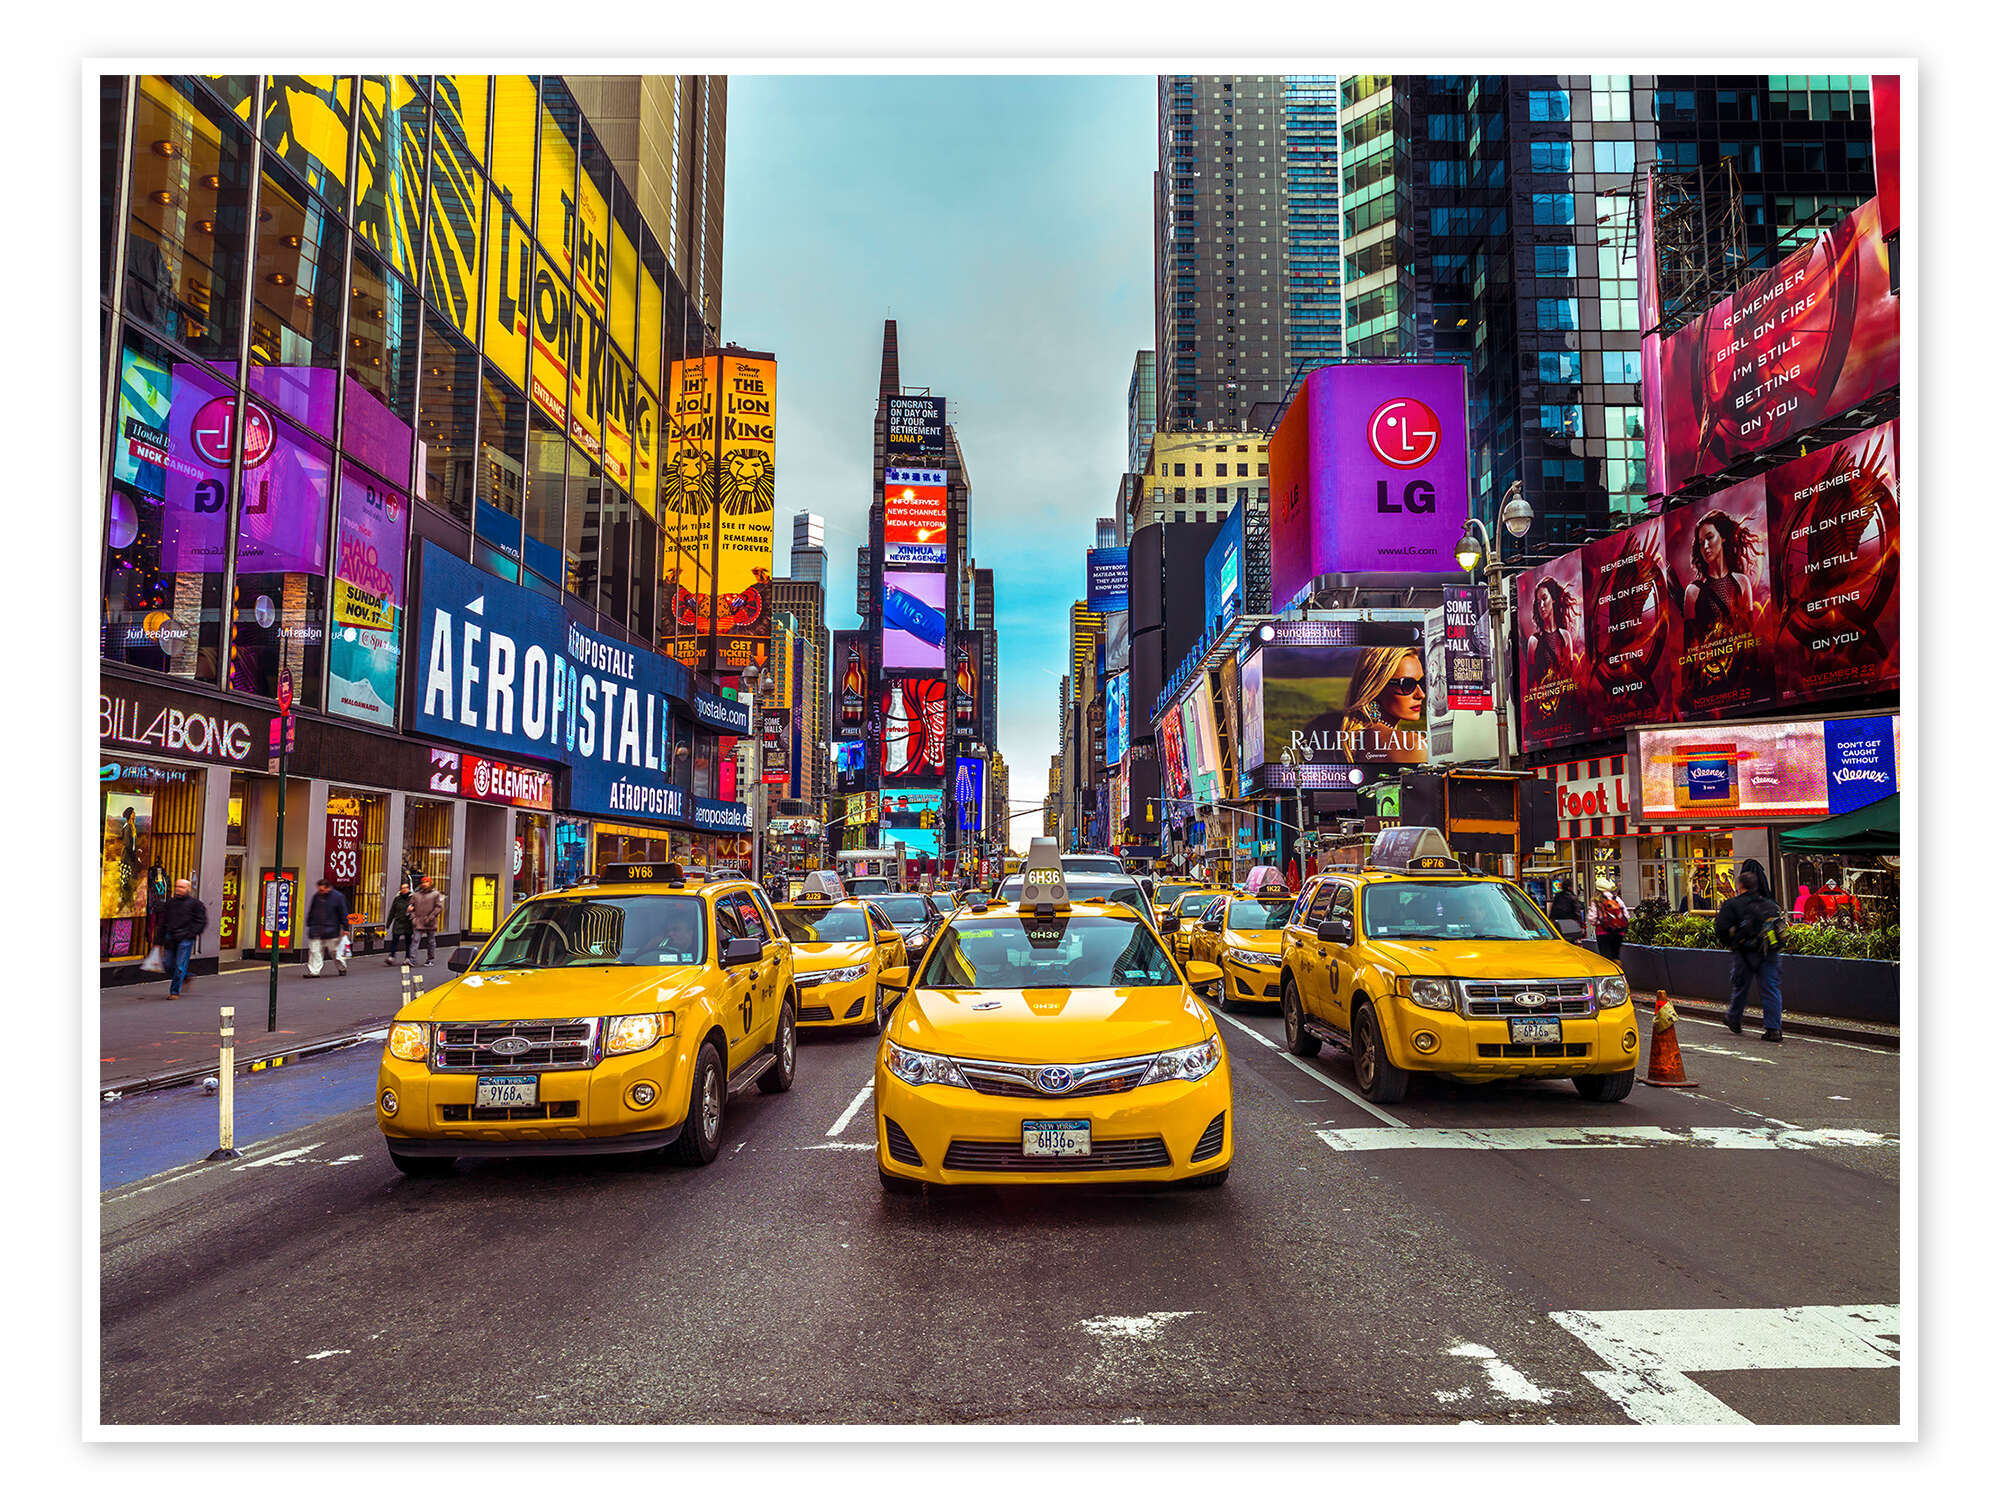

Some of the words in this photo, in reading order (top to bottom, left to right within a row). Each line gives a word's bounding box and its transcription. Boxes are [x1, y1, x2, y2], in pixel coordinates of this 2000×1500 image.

[561, 189, 606, 297] THE
[498, 184, 583, 379] LION
[1724, 269, 1805, 330] REMEMBER
[1717, 337, 1749, 363] GIRL
[1753, 319, 1774, 341] ON
[1781, 293, 1816, 323] FIRE
[1733, 363, 1752, 381] I'M
[1758, 336, 1800, 367] STILL
[736, 362, 760, 373] Disney
[587, 302, 651, 456] KING
[733, 378, 764, 392] THE
[1735, 365, 1800, 409] BETTING
[534, 382, 565, 421] ENTRANCE
[728, 393, 769, 413] LION
[890, 400, 933, 409] CONGRATS
[890, 409, 902, 417] ON
[904, 409, 920, 417] DAY
[922, 410, 938, 418] ONE
[890, 417, 900, 425] OF
[903, 417, 925, 426] YOUR
[1741, 416, 1761, 436] ON
[1766, 397, 1798, 421] YOU
[133, 424, 162, 445] Hosted
[724, 416, 774, 440] KING
[890, 426, 941, 435] RETIREMENT
[890, 434, 915, 443] DIANA
[917, 435, 925, 443] P.
[137, 445, 162, 463] NICK
[163, 455, 205, 480] CANNON
[1794, 469, 1861, 501] REMEMBER
[1377, 480, 1435, 514] LG
[909, 508, 946, 516] CHANNELS
[722, 522, 735, 530] SEE
[1791, 521, 1817, 540] GIRL
[1819, 516, 1838, 532] ON
[1840, 506, 1868, 528] FIRE
[724, 535, 768, 544] REMEMBER
[341, 529, 378, 568] HALO
[897, 546, 934, 555] XINHUA
[1377, 547, 1438, 555] www.LG.com
[1601, 552, 1644, 574] REMEMBER
[1804, 562, 1821, 575] I'M
[1823, 551, 1858, 571] STILL
[338, 554, 393, 595] AWARDS
[346, 586, 381, 609] SUNDA
[1598, 591, 1616, 606] GIRL
[1618, 588, 1630, 600] ON
[1631, 582, 1649, 595] FIRE
[1807, 591, 1861, 612] BETTING
[346, 602, 370, 621] NOV.
[1446, 600, 1472, 613] SOME
[1447, 613, 1476, 626] WALLS
[1608, 622, 1619, 632] I'M
[1620, 618, 1642, 630] STILL
[1277, 626, 1321, 640] sunglass
[1323, 626, 1342, 638] hut
[1447, 626, 1466, 638] CAN
[730, 641, 752, 650] GET
[1448, 639, 1470, 651] TALK
[1812, 637, 1830, 650] ON
[1833, 632, 1859, 645] YOU
[719, 649, 752, 658] TICKETS
[1609, 649, 1644, 664] BETTING
[1678, 644, 1734, 665] CATCHING
[1737, 637, 1762, 650] FIRE
[1802, 666, 1858, 683] NOVEMBER
[1523, 688, 1560, 703] CATCHING
[1562, 683, 1579, 693] FIRE
[1612, 685, 1625, 695] ON
[1625, 682, 1643, 692] YOU
[100, 694, 251, 760] BILLABONG
[764, 717, 780, 726] SOME
[764, 725, 783, 734] WALLS
[764, 733, 776, 741] CAN
[1291, 730, 1365, 750] RALPH
[1374, 730, 1428, 750] LAUR
[1837, 741, 1863, 749] DON'T
[1865, 740, 1881, 748] GET
[1841, 756, 1878, 765] WITHOUT
[1843, 748, 1877, 757] CAUGHT
[1690, 767, 1727, 779] Kleenex
[1751, 776, 1780, 785] Kleenex
[1832, 768, 1887, 784] Kleenex
[491, 768, 545, 802] ELEMENT
[609, 776, 682, 817] AÉROPOSTALE
[1558, 782, 1608, 818] Foot
[1616, 778, 1631, 812] L
[332, 818, 358, 838] TEES
[337, 839, 342, 849] 3
[330, 851, 357, 877] $33
[1422, 858, 1445, 868] 6P76
[628, 866, 653, 878] 9Y68
[1029, 870, 1060, 884] 6H36
